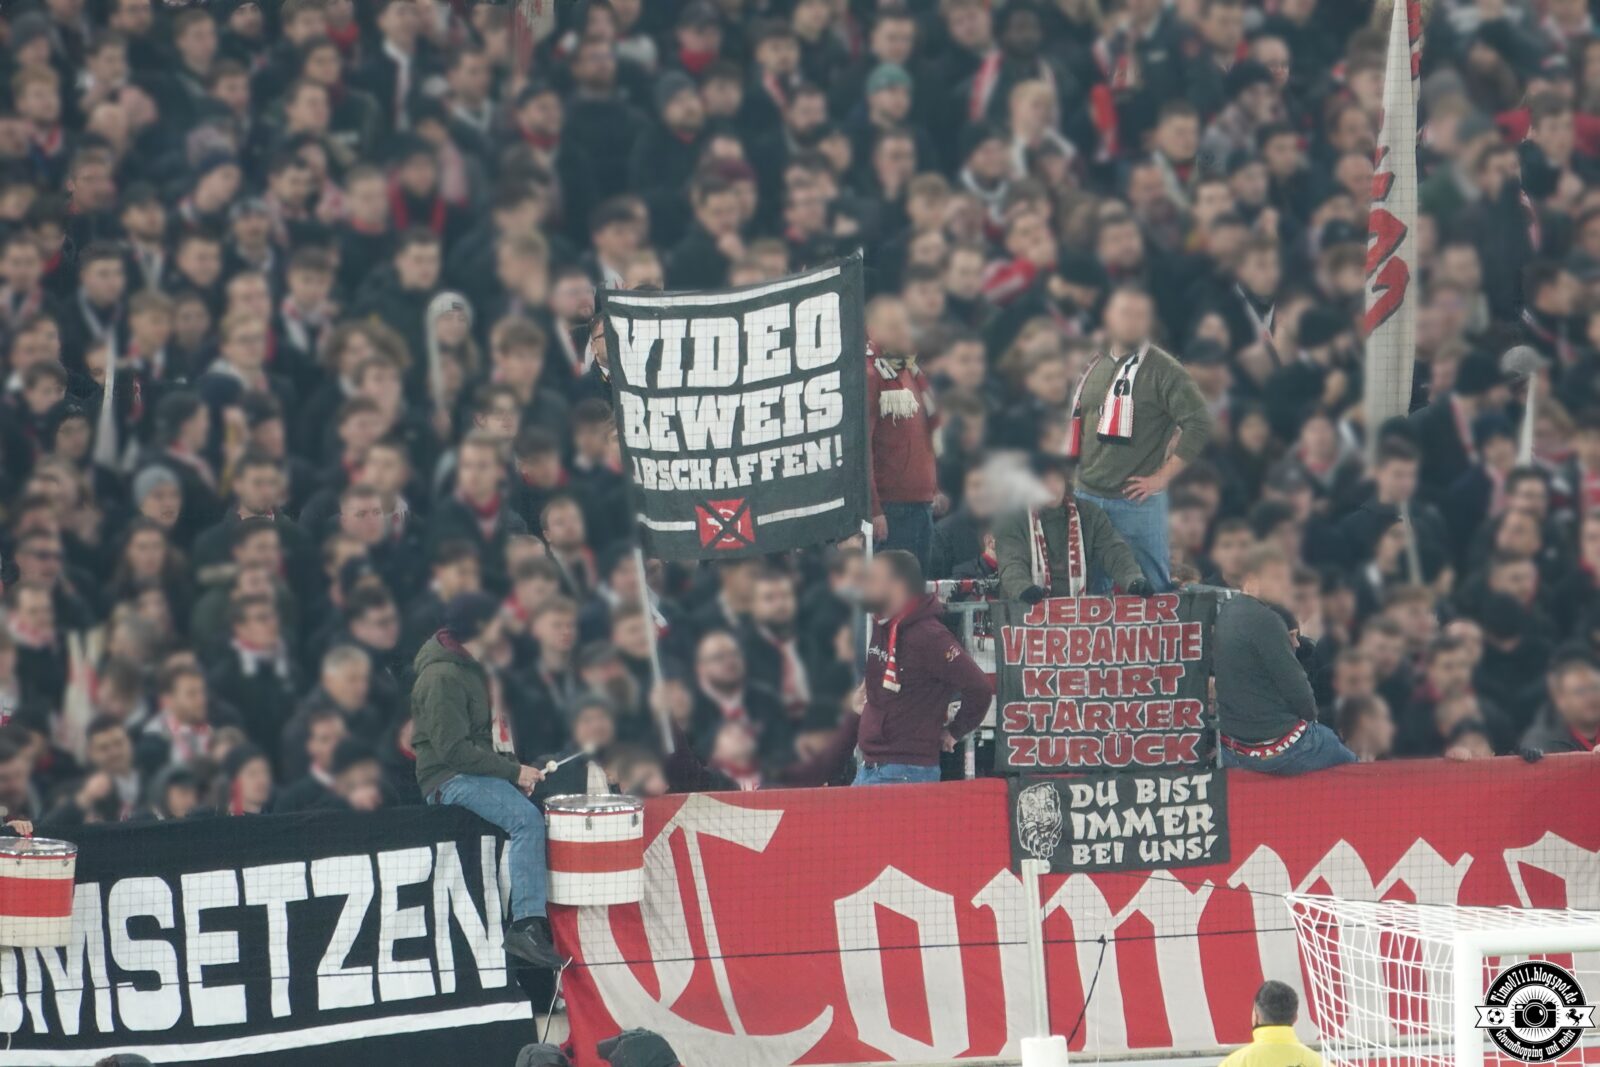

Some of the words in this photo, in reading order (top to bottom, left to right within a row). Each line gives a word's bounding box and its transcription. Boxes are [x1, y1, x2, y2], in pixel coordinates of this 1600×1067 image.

[610, 292, 842, 389] VIDEO
[620, 371, 844, 452] BEWEIS
[1024, 593, 1180, 625] JEDER
[1001, 622, 1202, 666] VERBANNTE
[1022, 663, 1185, 698] KEHRT
[1002, 699, 1205, 732] STÄRKER
[1007, 732, 1202, 767] ZURÜCK
[1069, 779, 1120, 808] DU
[1134, 773, 1213, 804] BIST
[1070, 803, 1216, 840] IMMER
[1071, 841, 1125, 865] BEI
[1138, 835, 1219, 863] UNS!
